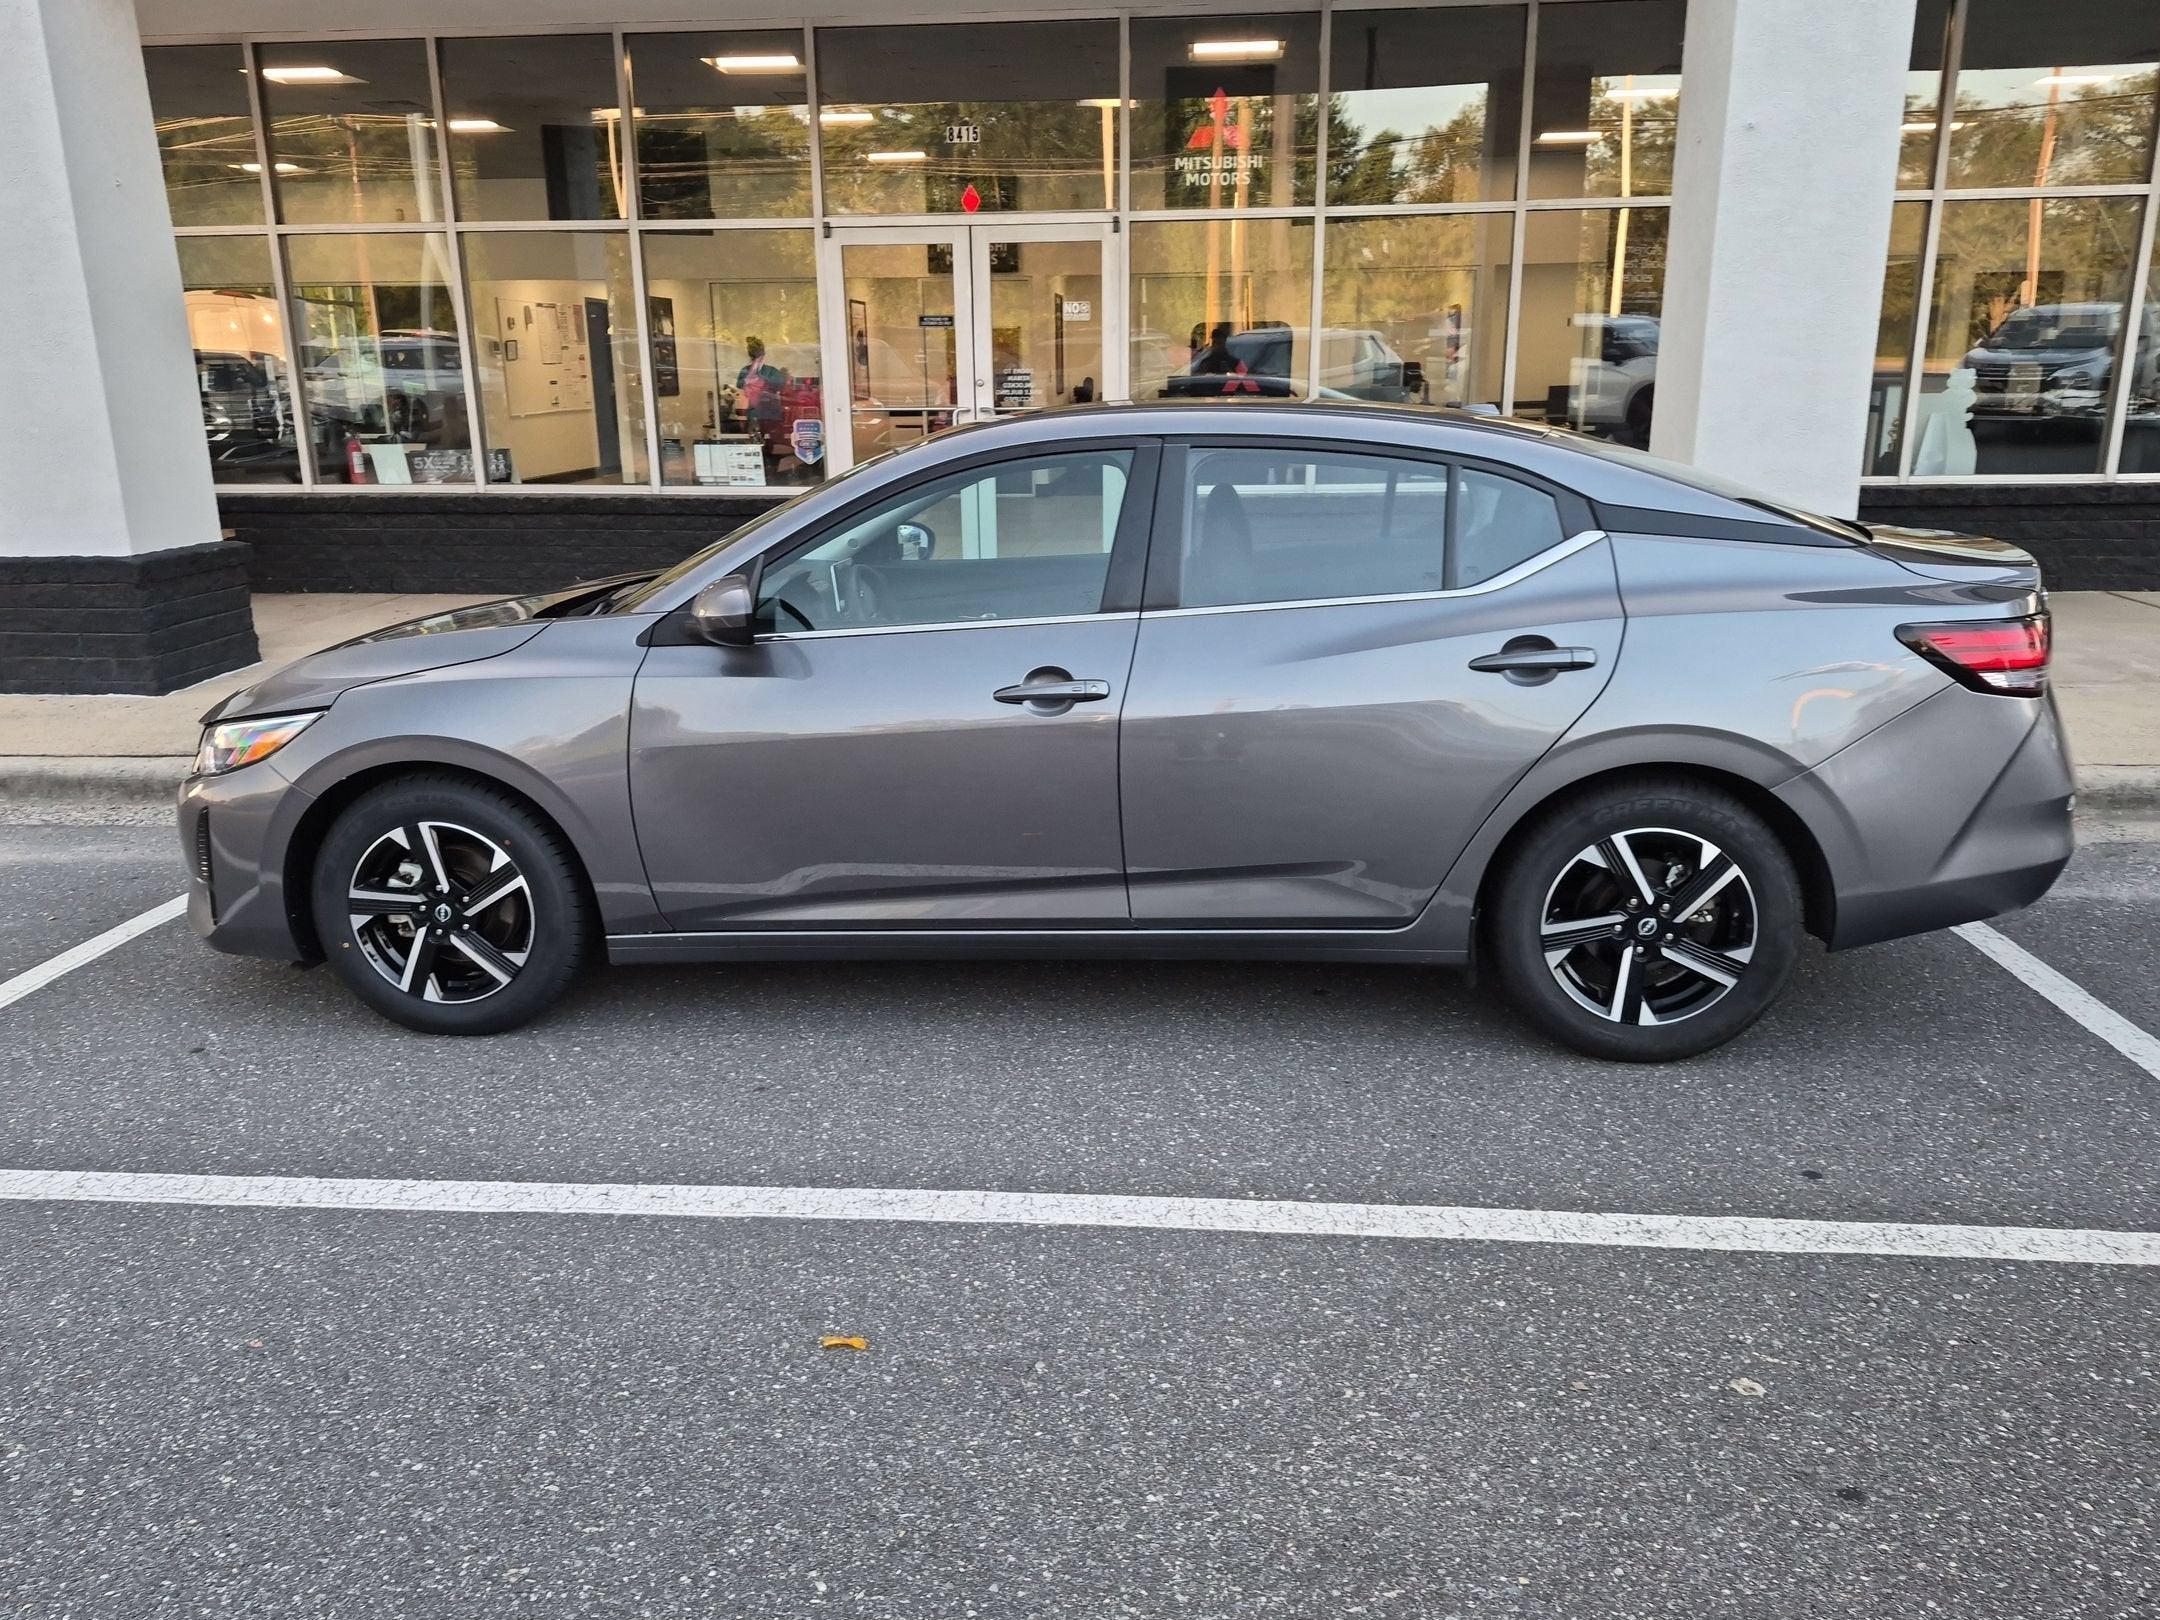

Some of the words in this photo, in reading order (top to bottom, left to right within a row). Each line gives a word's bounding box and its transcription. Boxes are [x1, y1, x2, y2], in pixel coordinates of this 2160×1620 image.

[948, 126, 978, 142] 8415
[1174, 154, 1263, 171] MITSUBISHI
[1185, 171, 1251, 187] MOTORS
[1064, 303, 1080, 313] NO
[414, 456, 435, 470] 5X
